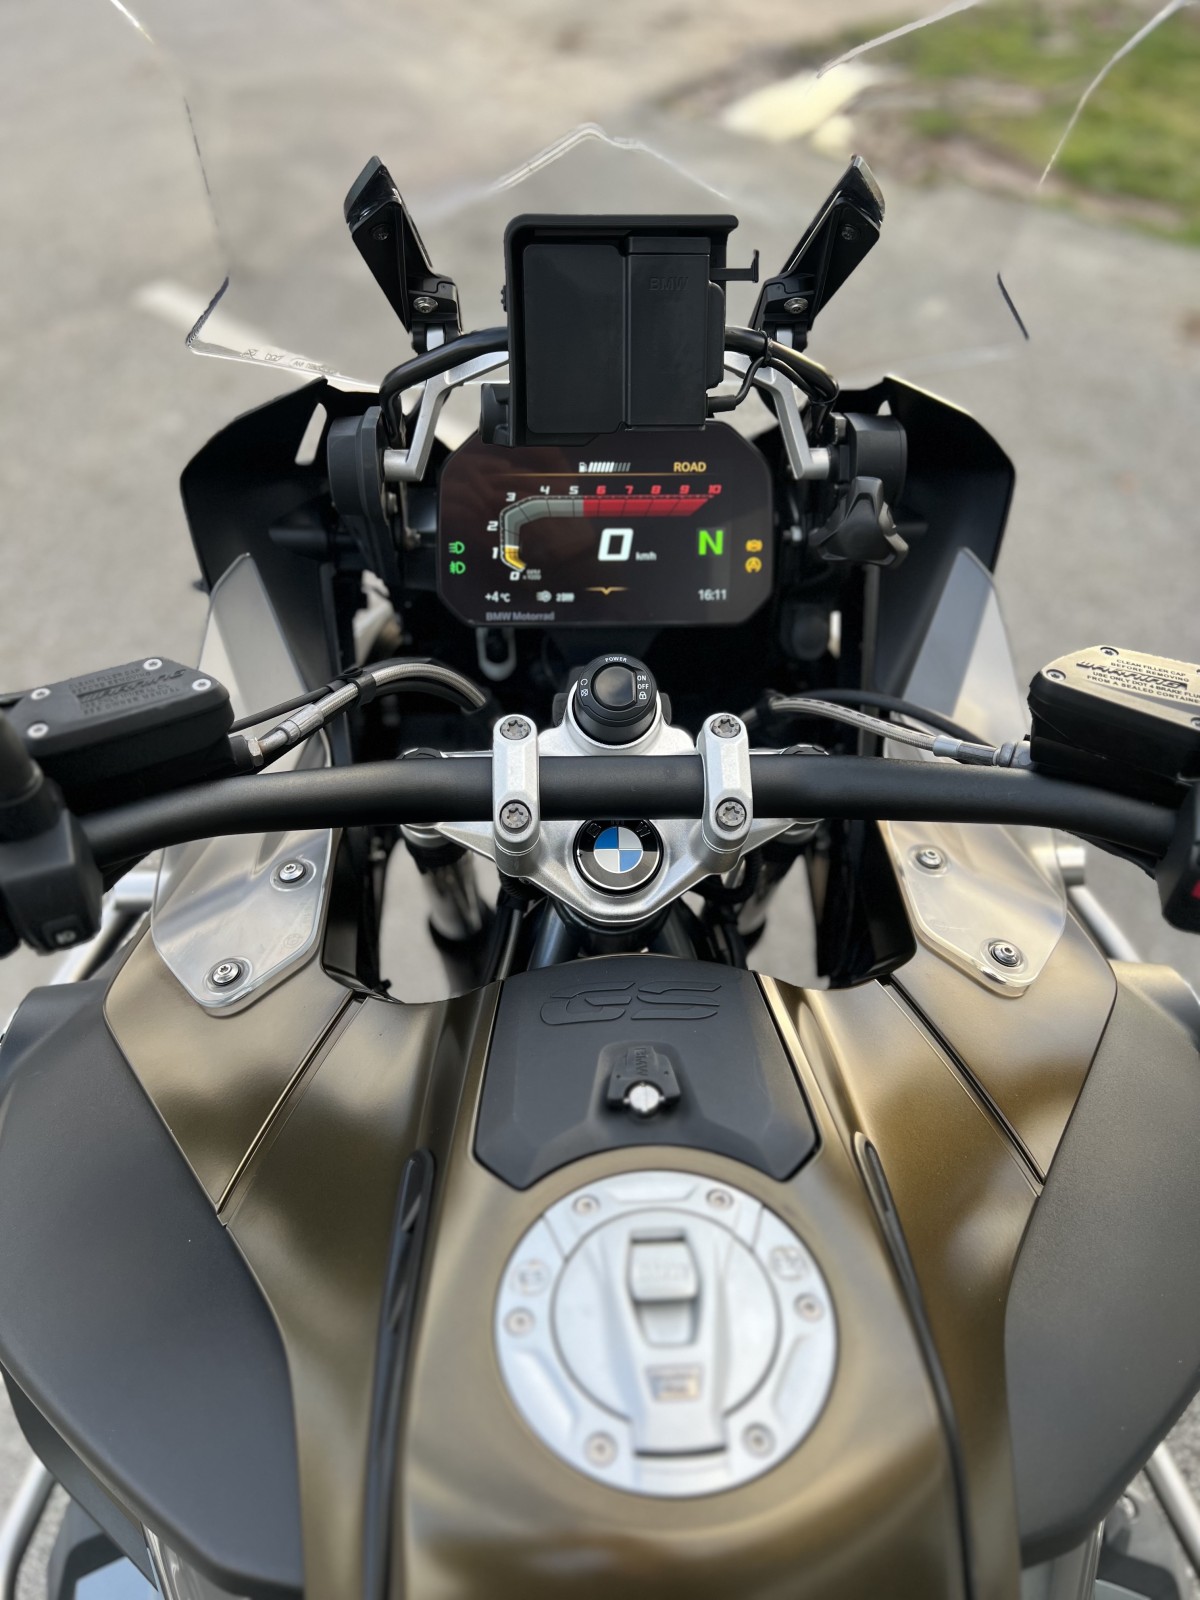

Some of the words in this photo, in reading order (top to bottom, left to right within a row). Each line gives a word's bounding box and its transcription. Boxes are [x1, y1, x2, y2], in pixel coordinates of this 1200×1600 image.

[649, 276, 688, 291] BMW
[673, 461, 707, 472] ROAD
[540, 485, 550, 495] 4
[568, 485, 579, 495] 5
[596, 485, 606, 495] 6
[625, 485, 634, 495] 7
[651, 485, 661, 495] 8
[680, 484, 690, 494] 9
[708, 484, 722, 494] 10
[506, 492, 516, 502] 3
[487, 521, 499, 532] 2
[598, 527, 634, 561] 0
[698, 529, 724, 555] N
[492, 546, 499, 559] 1
[509, 571, 520, 581] 0
[698, 588, 727, 601] 16:11
[485, 611, 511, 621] BMW
[512, 611, 555, 621] Motorrad
[1110, 662, 1143, 672] BEFORE
[1146, 670, 1189, 682] REMOVING
[1116, 659, 1142, 668] CLEAN
[1143, 665, 1169, 673] FILLER
[1087, 675, 1110, 683] FROM
[1121, 683, 1153, 693] SEALED
[1110, 675, 1130, 683] ONLY
[540, 981, 722, 1026] GS
